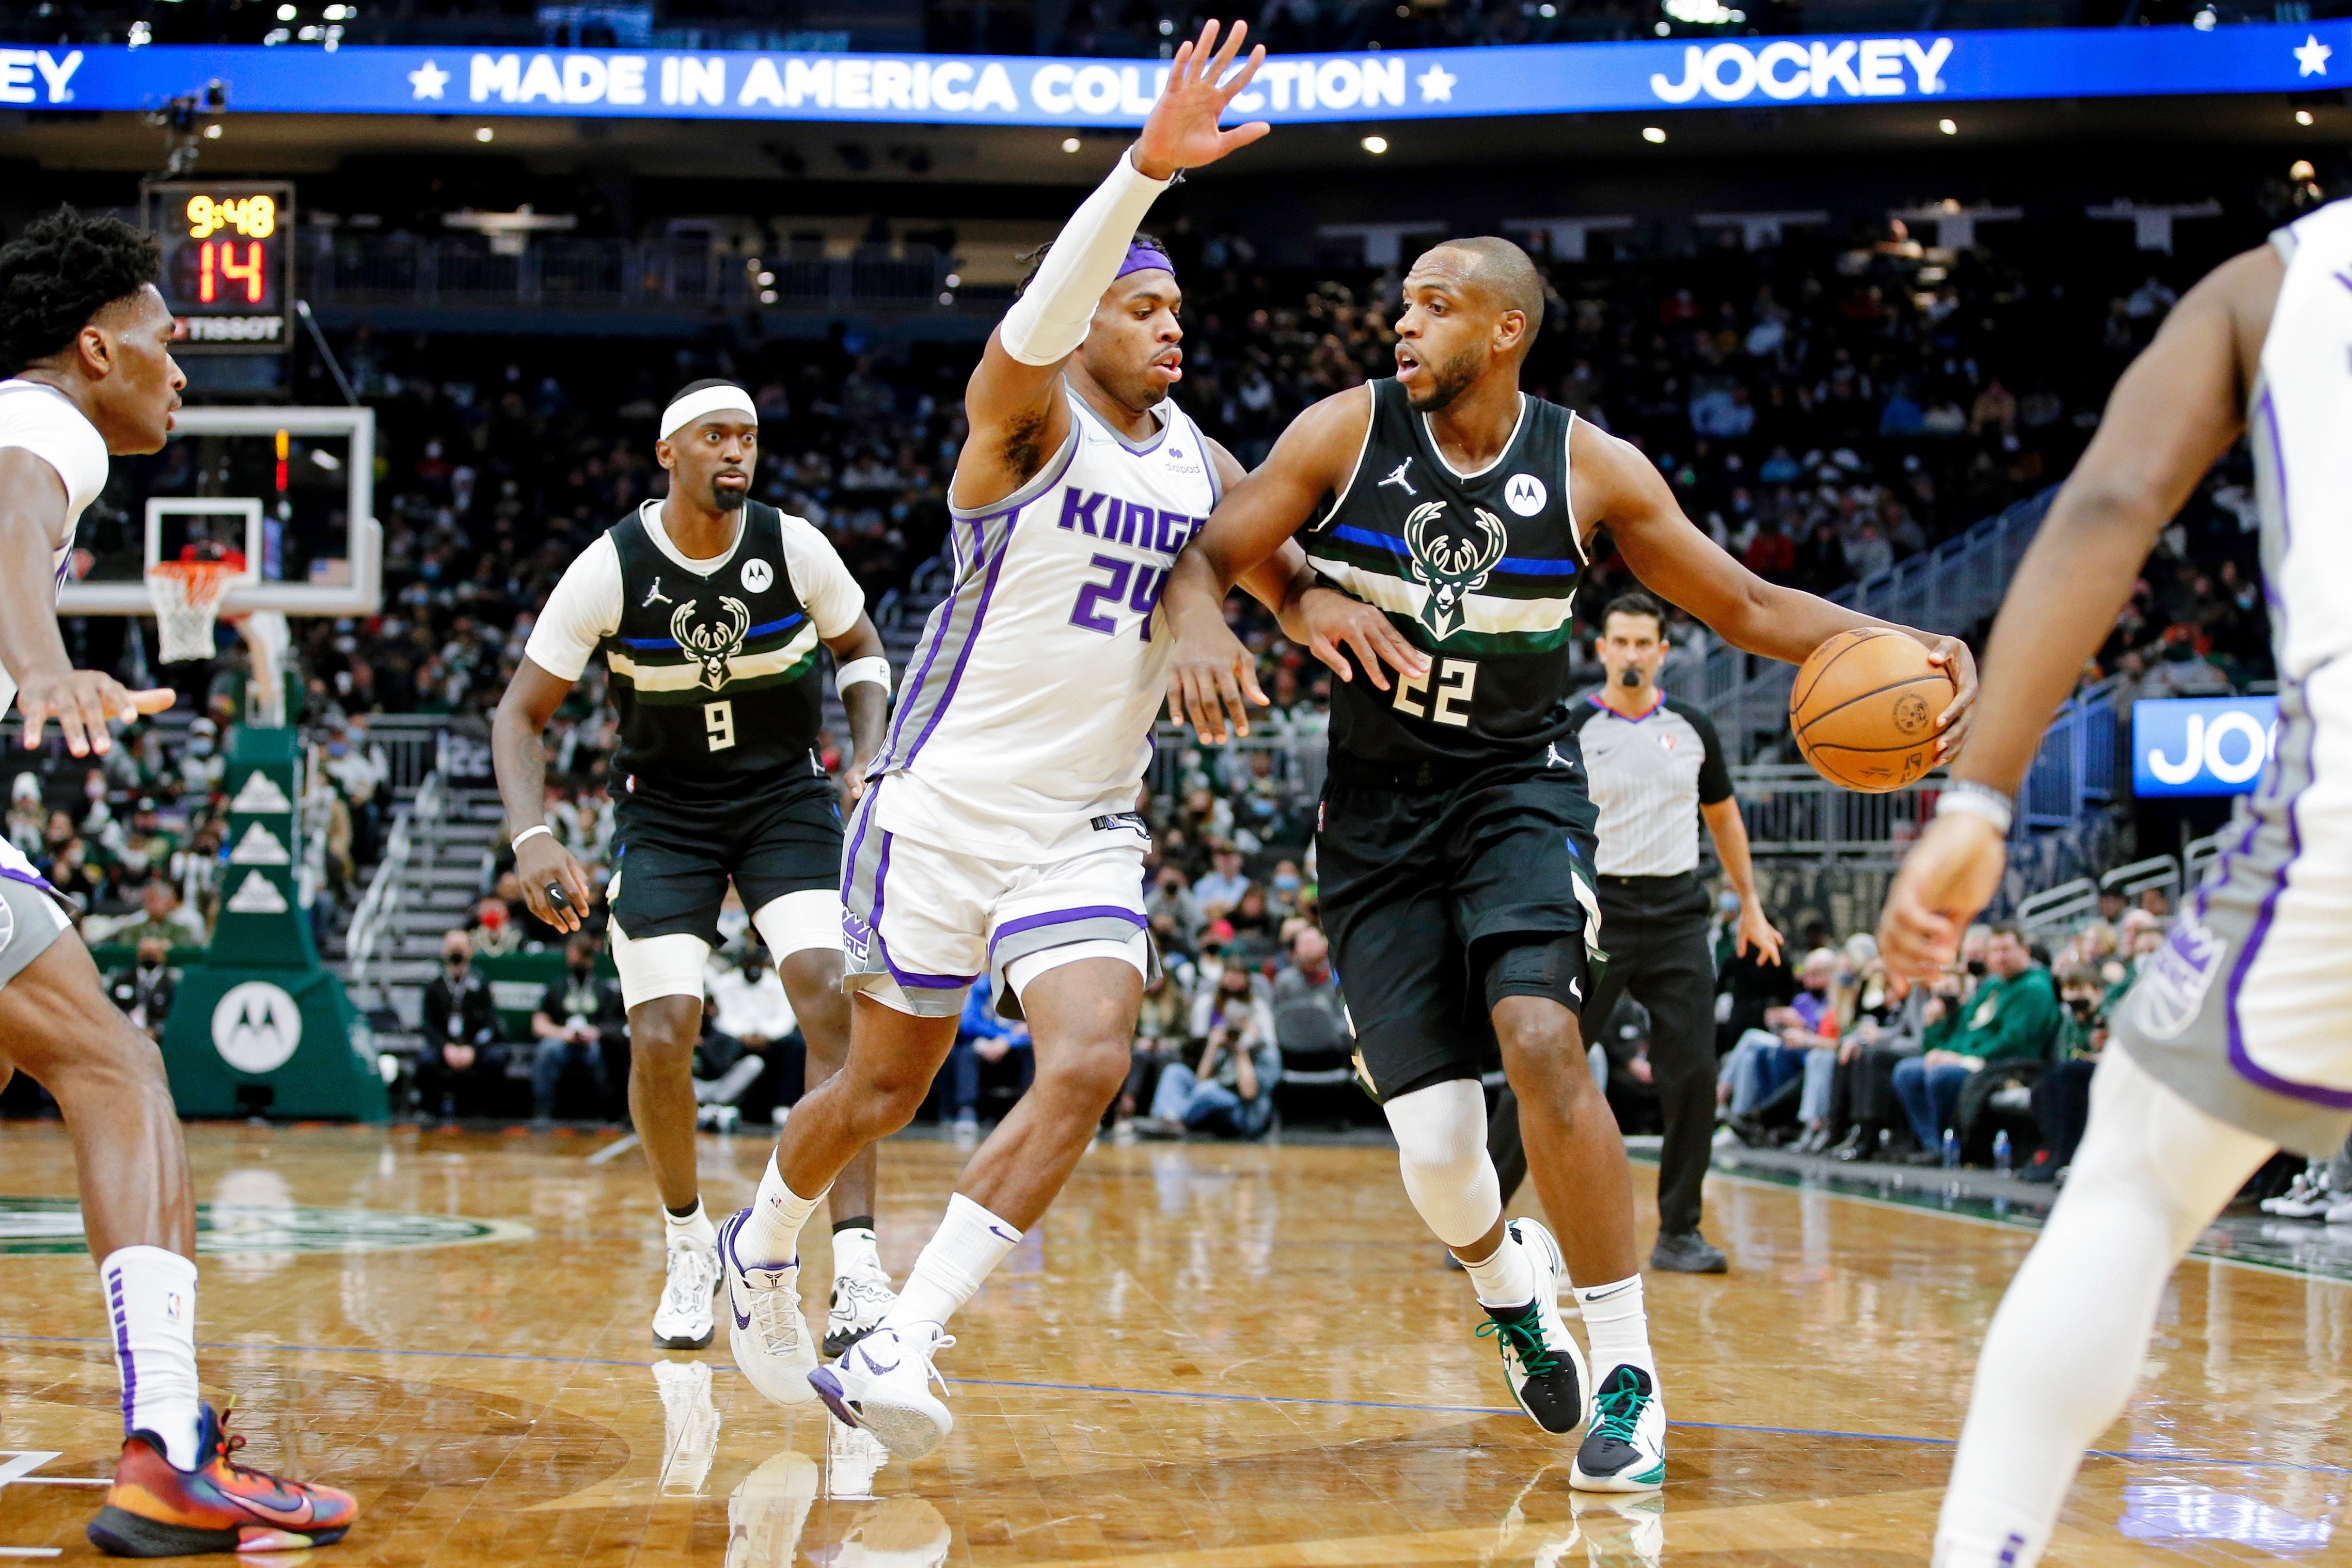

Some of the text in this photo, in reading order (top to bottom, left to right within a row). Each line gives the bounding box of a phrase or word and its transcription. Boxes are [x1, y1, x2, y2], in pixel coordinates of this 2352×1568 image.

[469, 53, 1406, 115] MADE IN AMERICA COLCTION
[1650, 37, 1954, 104] JOCKEY
[186, 195, 274, 239] 9:48
[199, 241, 264, 304] 14
[1067, 552, 1171, 642] 24
[1393, 648, 1479, 727] 22
[703, 700, 736, 752] 9
[2149, 711, 2278, 784] JO
